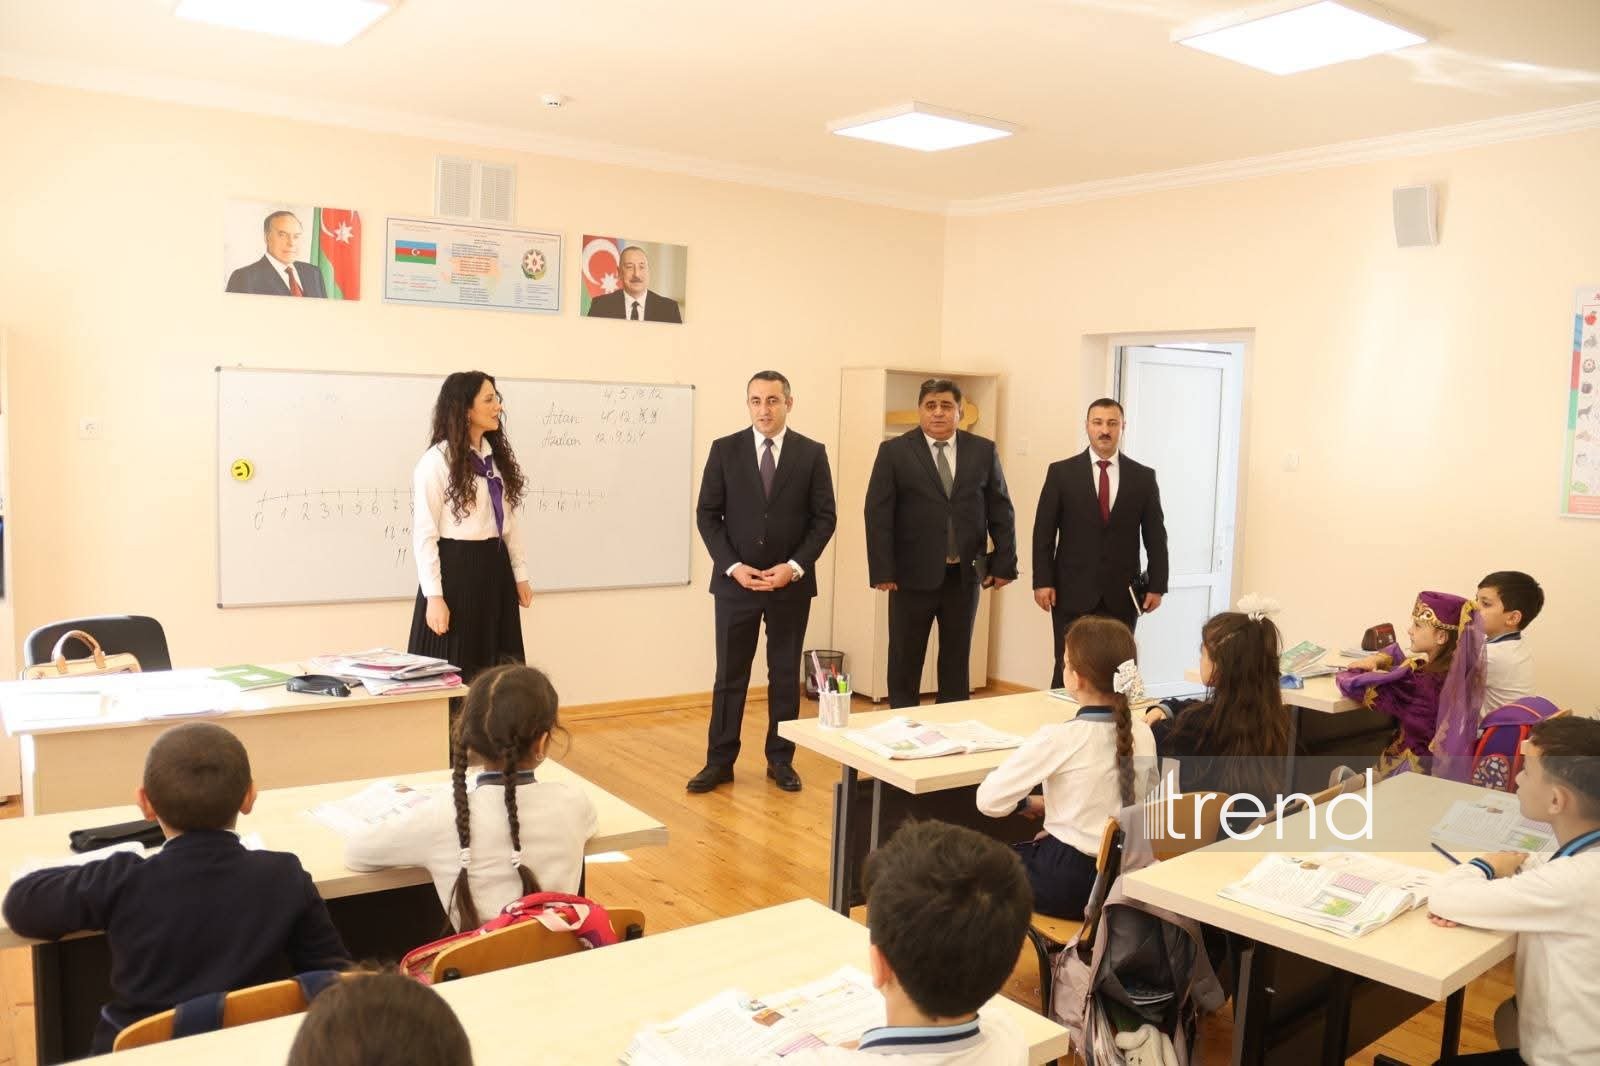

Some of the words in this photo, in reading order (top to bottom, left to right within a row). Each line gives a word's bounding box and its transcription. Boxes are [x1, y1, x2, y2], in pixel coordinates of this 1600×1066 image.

[302, 502, 311, 520] 2
[319, 503, 330, 519] 3
[353, 504, 362, 516] 5
[370, 500, 379, 514] 6
